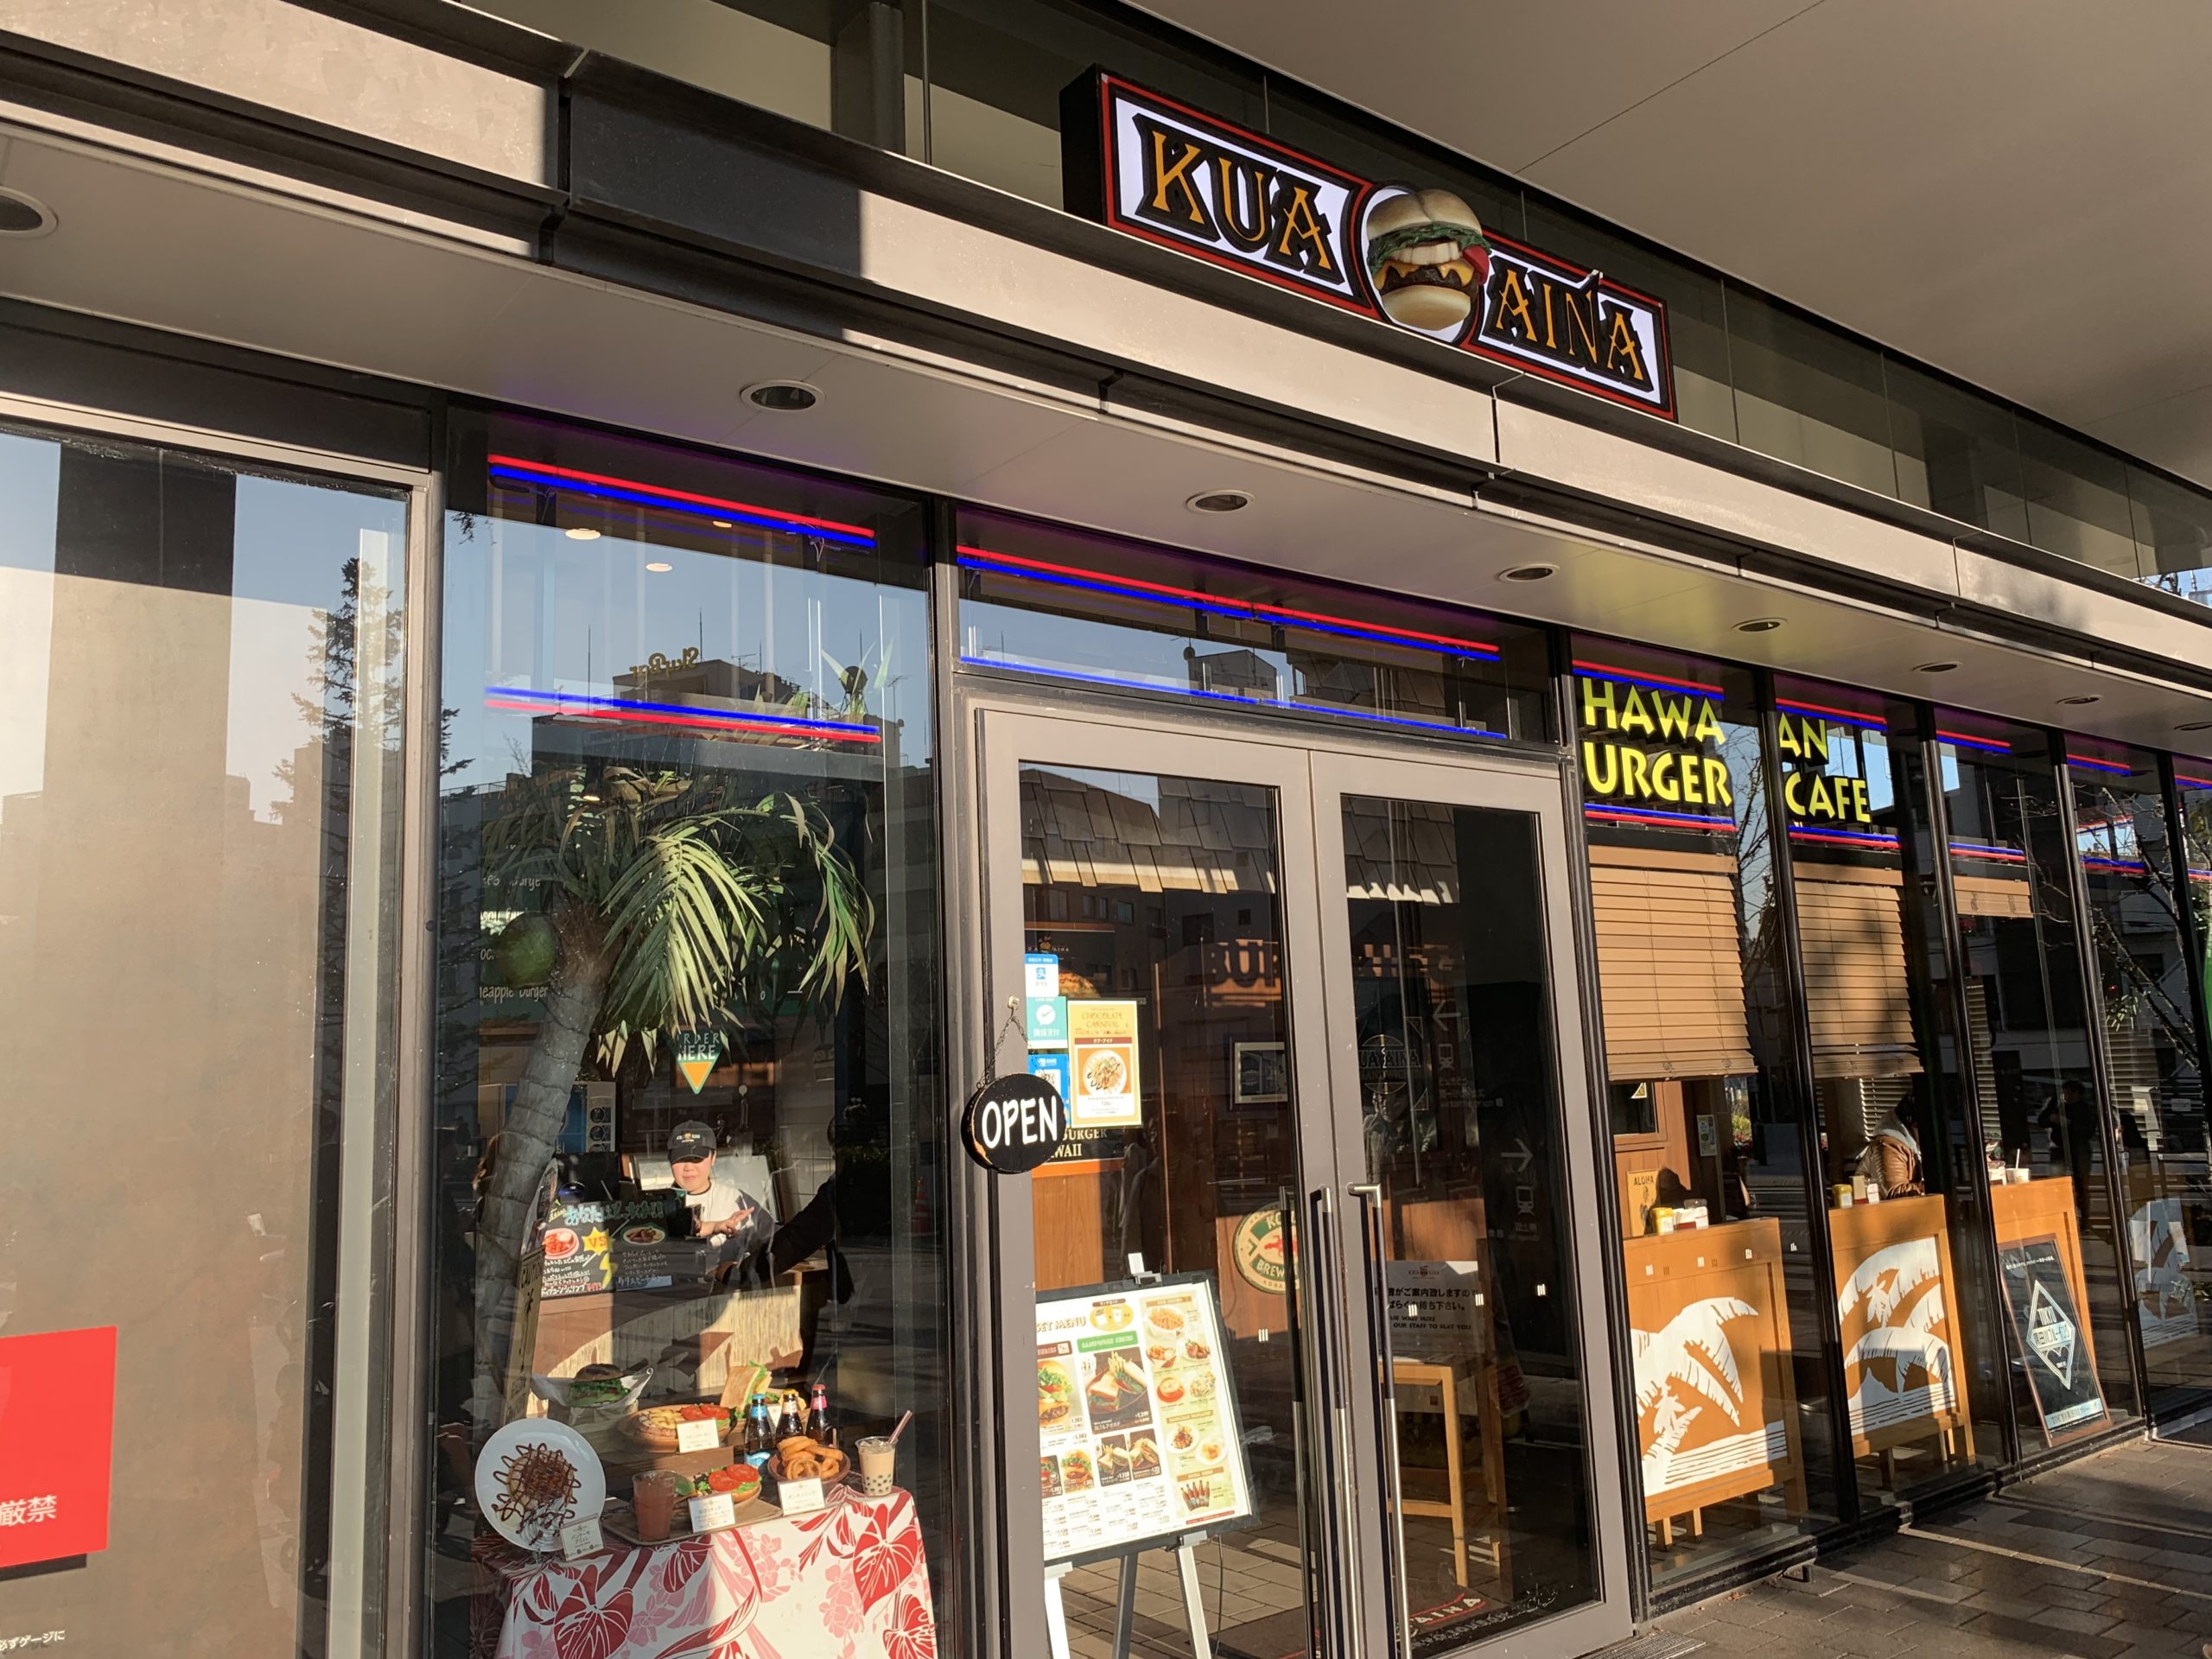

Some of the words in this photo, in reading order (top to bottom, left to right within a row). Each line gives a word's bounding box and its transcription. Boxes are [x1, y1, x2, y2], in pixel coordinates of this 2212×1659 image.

[1145, 124, 1336, 275] KUA
[1582, 677, 1726, 745] HAWA
[1778, 712, 1829, 762] AN
[1584, 741, 1732, 807] URGER
[1785, 771, 1872, 823] CAFE
[677, 1031, 720, 1045] RDER
[982, 1095, 1058, 1149] OPEN
[1051, 1143, 1083, 1158] WAII
[1634, 1175, 1655, 1185] ALOHA
[1055, 1316, 1087, 1331] MENU
